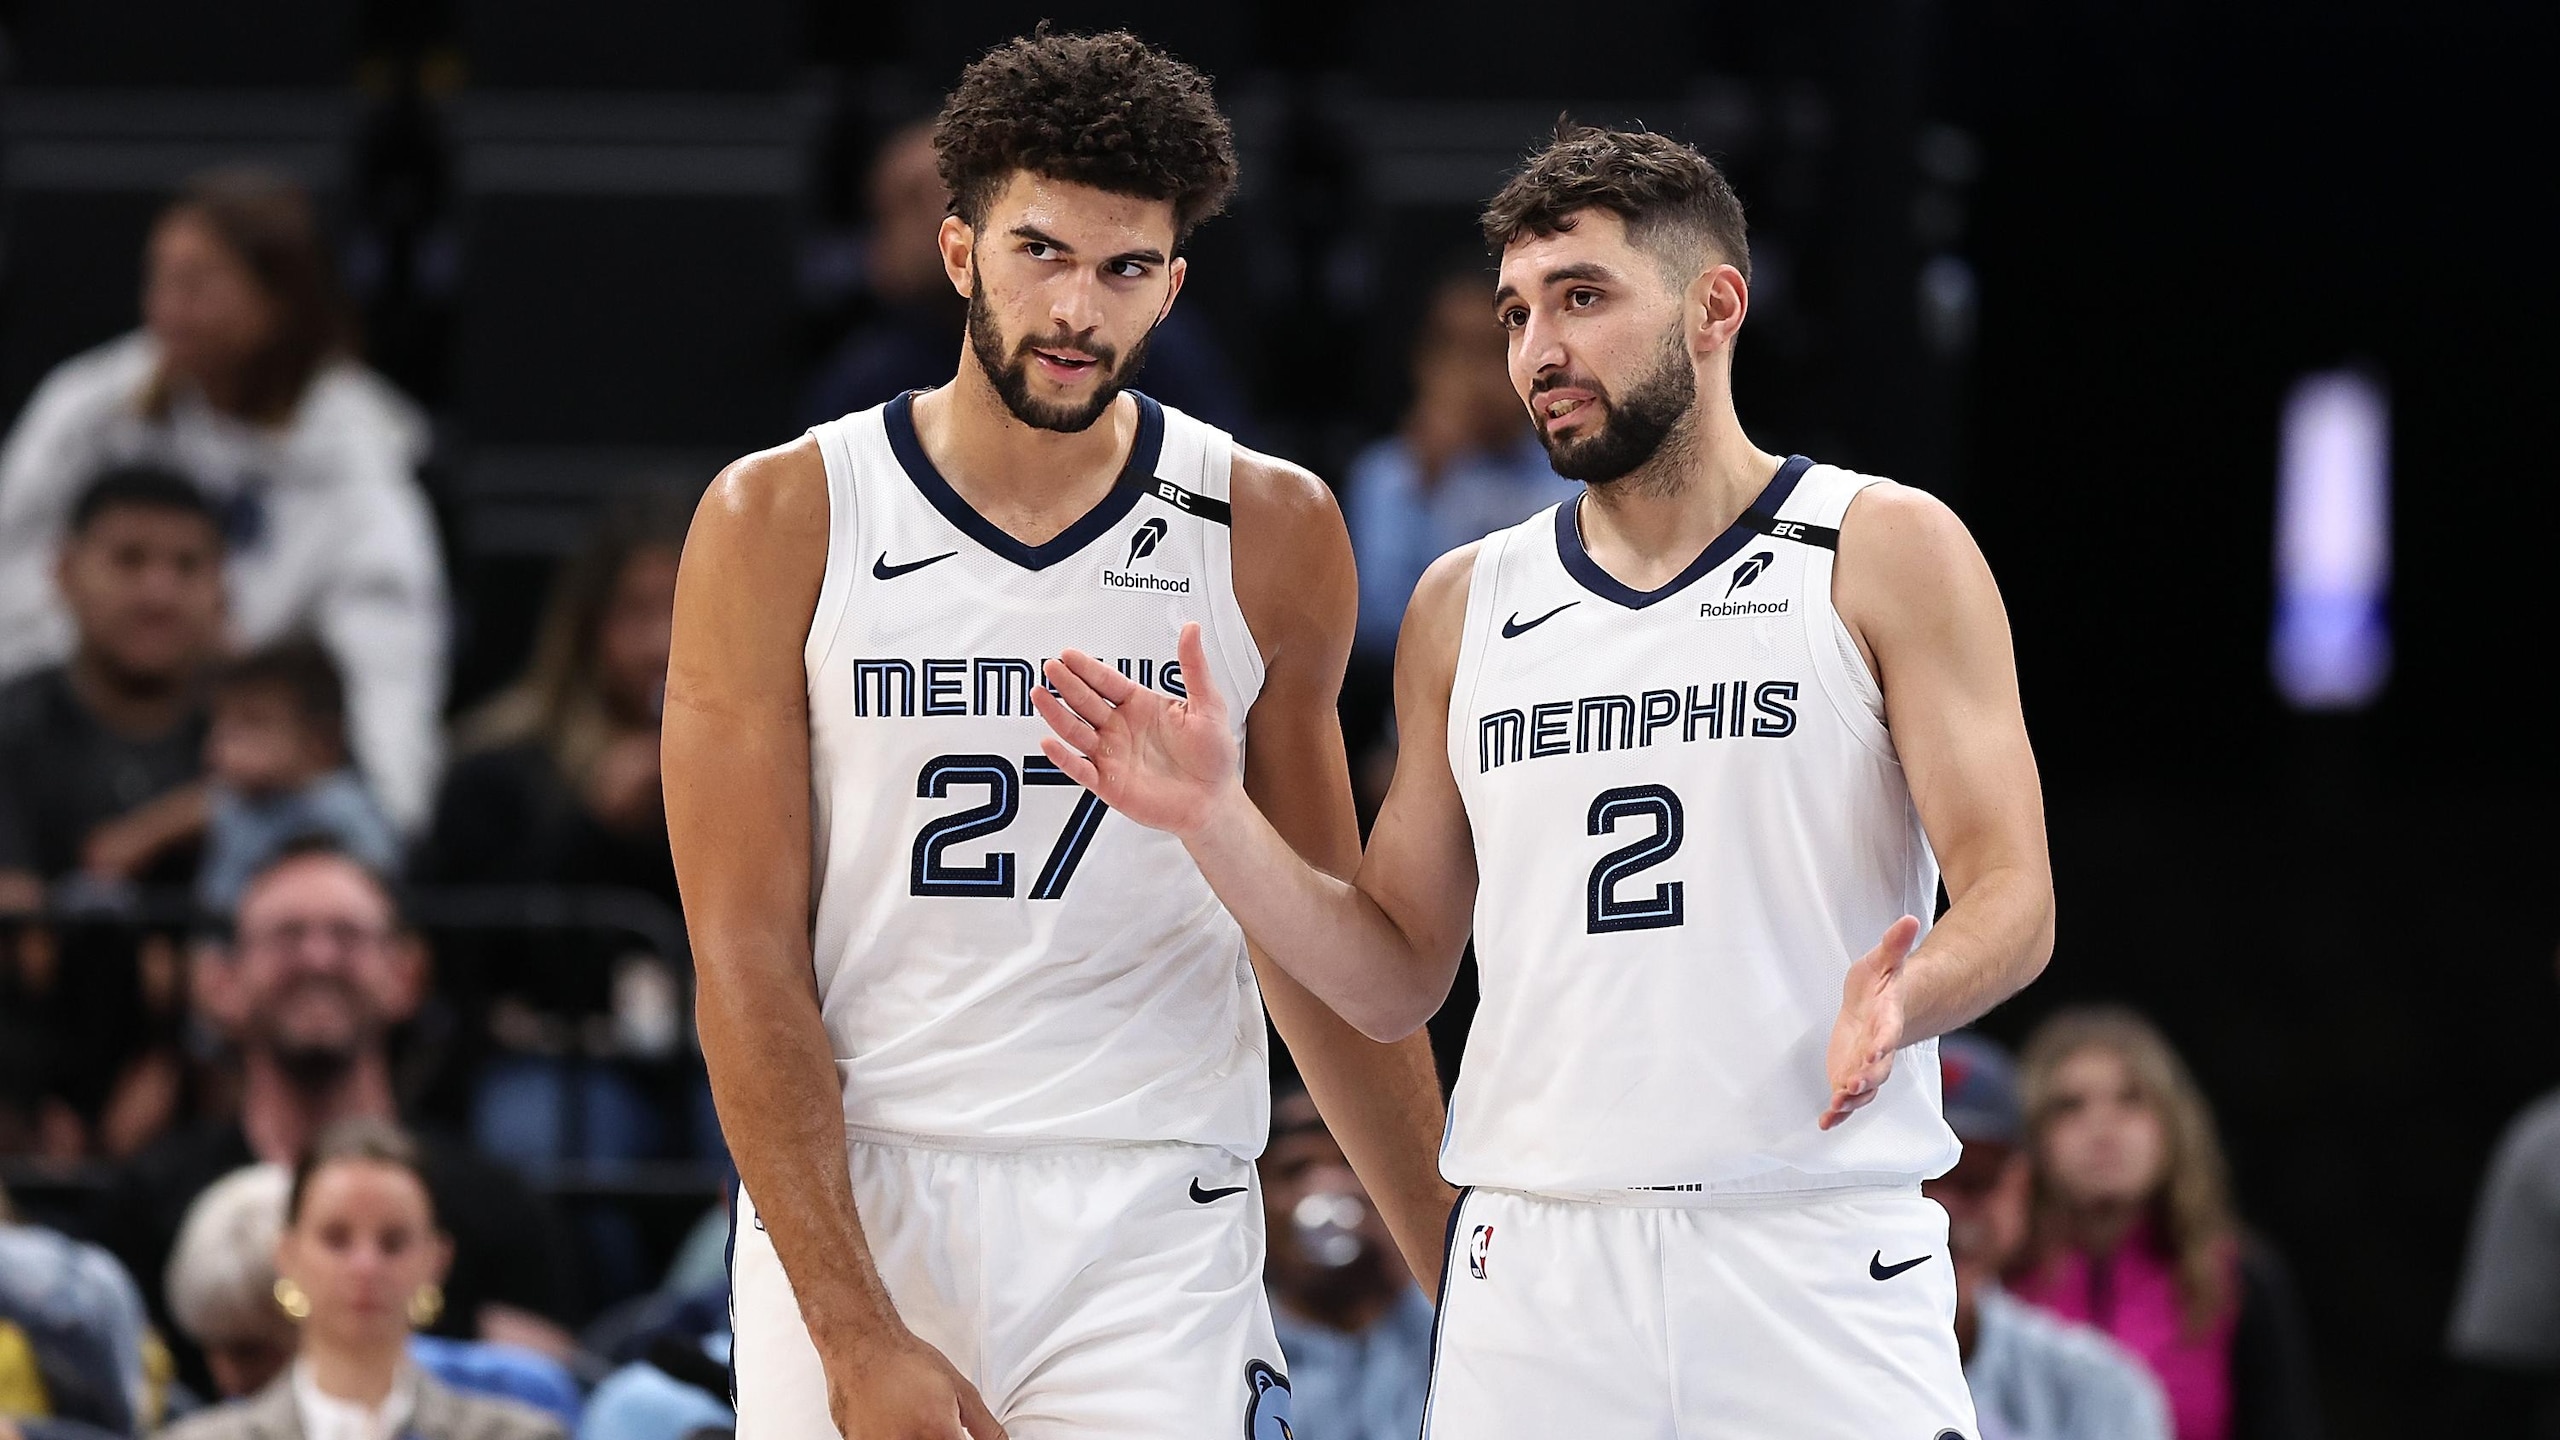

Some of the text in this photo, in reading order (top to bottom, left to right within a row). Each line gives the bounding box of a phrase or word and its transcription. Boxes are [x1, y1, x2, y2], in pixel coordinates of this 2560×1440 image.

[1158, 482, 1191, 510] BC
[1771, 522, 1806, 540] BC
[1103, 570, 1190, 593] Robinhood
[1700, 598, 1789, 617] Robinhood
[853, 657, 1188, 718] MEMI
[1479, 680, 1799, 774] MEMPHIS
[910, 754, 1110, 900] 27
[1587, 783, 1684, 934] 2
